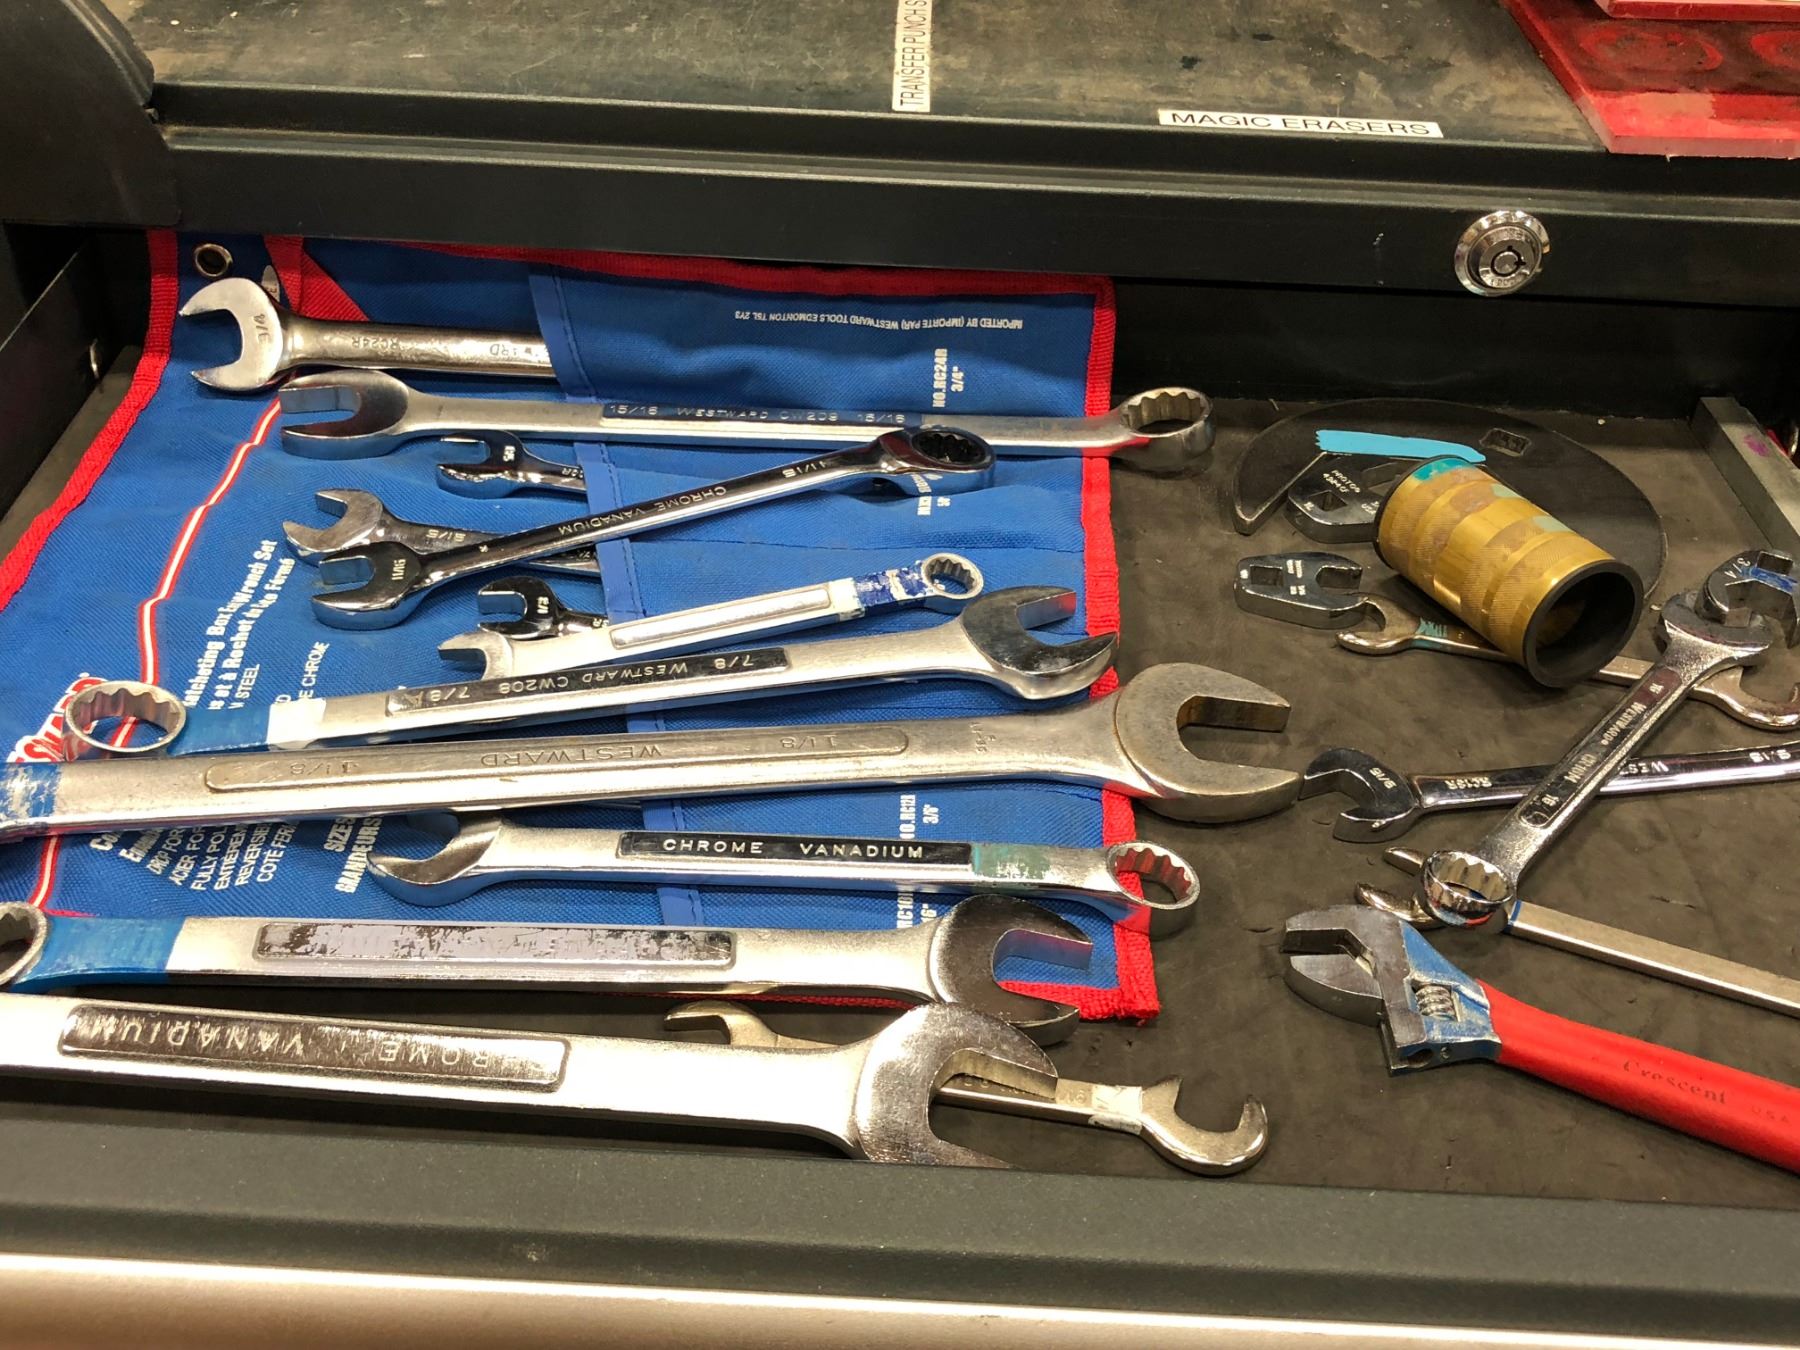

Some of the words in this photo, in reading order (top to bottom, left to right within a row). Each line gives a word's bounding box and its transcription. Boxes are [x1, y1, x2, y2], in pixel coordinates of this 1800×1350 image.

[900, 47, 925, 106] TRANSFER
[1171, 112, 1272, 128] MAGIC
[1282, 118, 1430, 136] ERASERS
[768, 310, 818, 323] EDMONTON
[820, 311, 848, 325] TOOLS
[850, 315, 899, 330] WESTWARD
[900, 319, 921, 331] PAR)
[921, 316, 965, 329] (IMPORTE
[966, 317, 979, 328] BY
[979, 318, 1024, 330] IMPORTED
[932, 348, 948, 408] NO.RC24R
[951, 366, 964, 392] 3/4"
[609, 404, 658, 416] 15/16
[676, 406, 769, 420] WESTWARD
[654, 486, 727, 512] CHROME
[557, 507, 642, 535] VANADIUM
[206, 613, 233, 636] Box
[231, 562, 268, 603] Wrench
[253, 539, 278, 561] Set
[222, 619, 256, 669] Rochet
[301, 641, 330, 687] CHROME
[582, 662, 688, 684] WESTWARD
[715, 655, 754, 671] 7/8
[235, 663, 260, 699] STEEL
[429, 685, 471, 702] 7/8
[499, 676, 569, 695] CW208
[480, 743, 662, 769] WESTWARD
[162, 827, 187, 853] FOR
[661, 838, 765, 855] CHROME
[799, 843, 925, 860] VANADIUM
[335, 816, 382, 894] GRANDEURS
[169, 853, 198, 886] ACIER
[190, 856, 219, 891] FULLY
[86, 1013, 304, 1056] VANADIUM
[1623, 1060, 1726, 1104] Crescent
